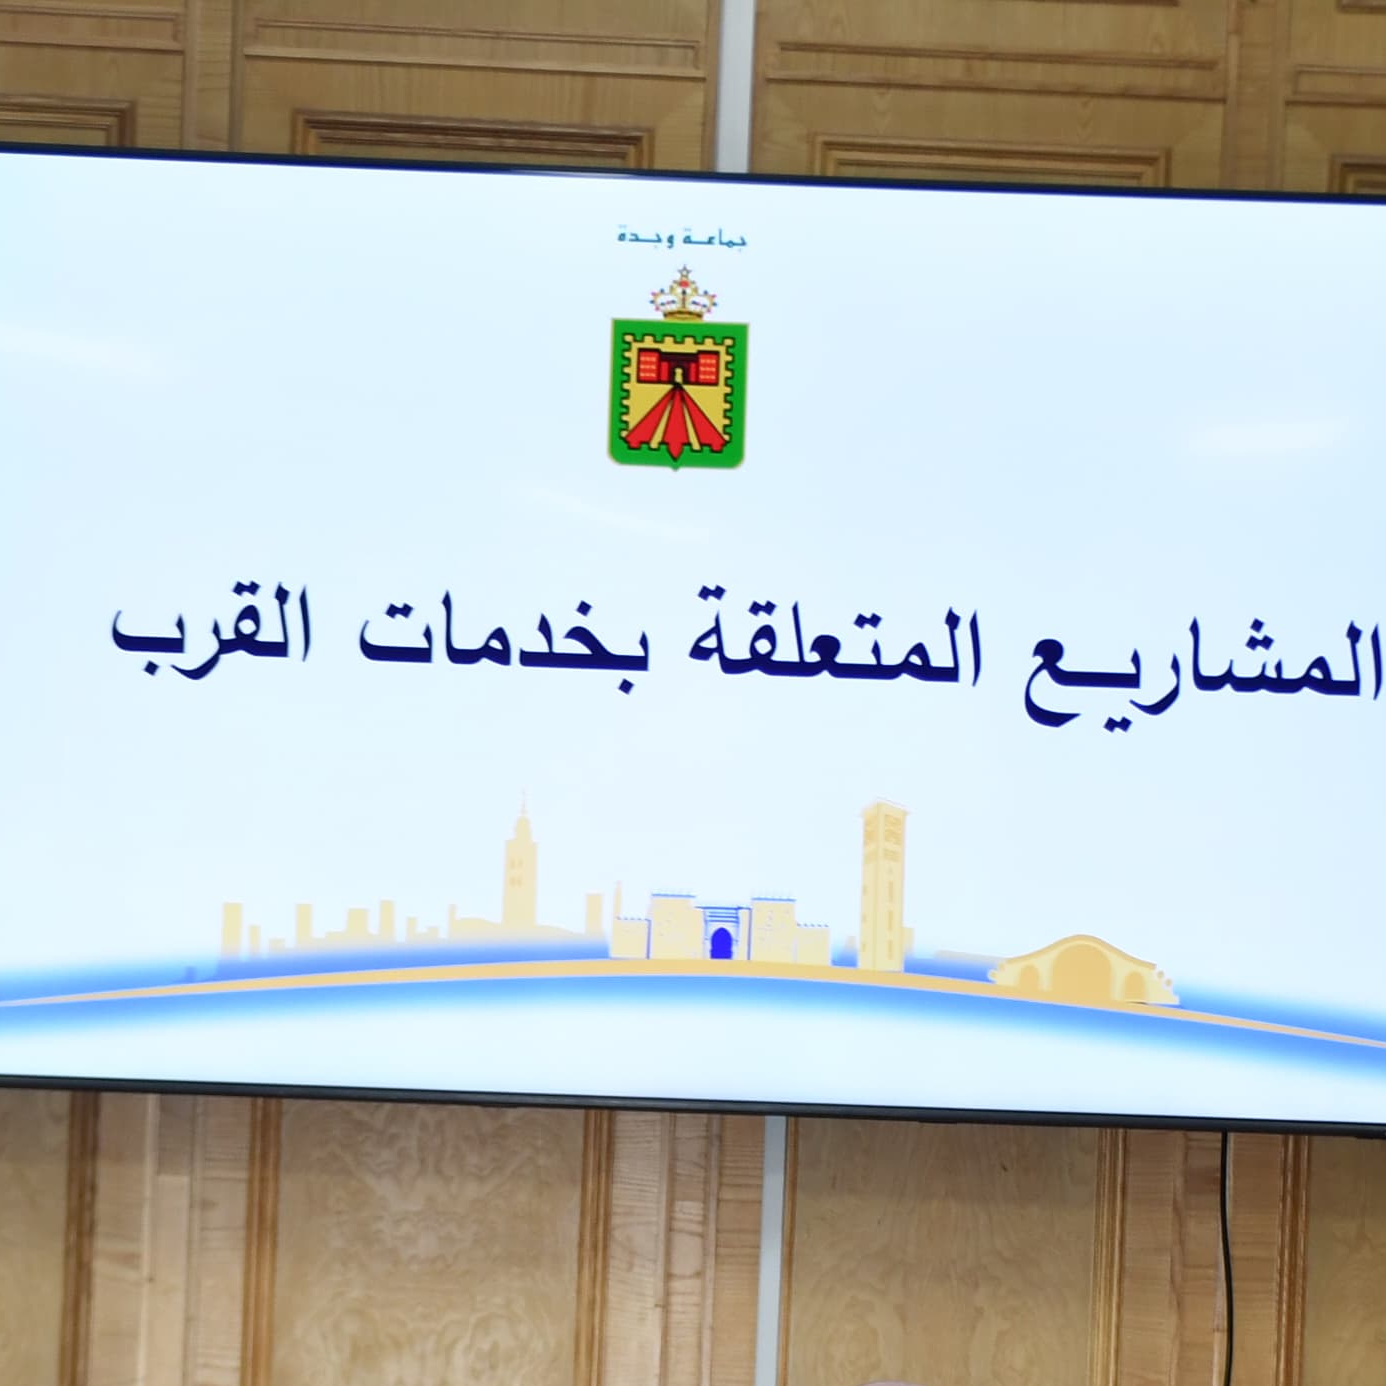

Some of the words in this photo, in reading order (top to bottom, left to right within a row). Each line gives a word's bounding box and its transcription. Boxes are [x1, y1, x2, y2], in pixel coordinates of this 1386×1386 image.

[616, 223, 675, 250] وجدة
[682, 226, 748, 252] جماعة
[111, 580, 311, 681] القرب
[359, 590, 649, 695] بخدمات
[688, 583, 982, 688] المتعلقة
[1024, 616, 1383, 734] المشاريع
